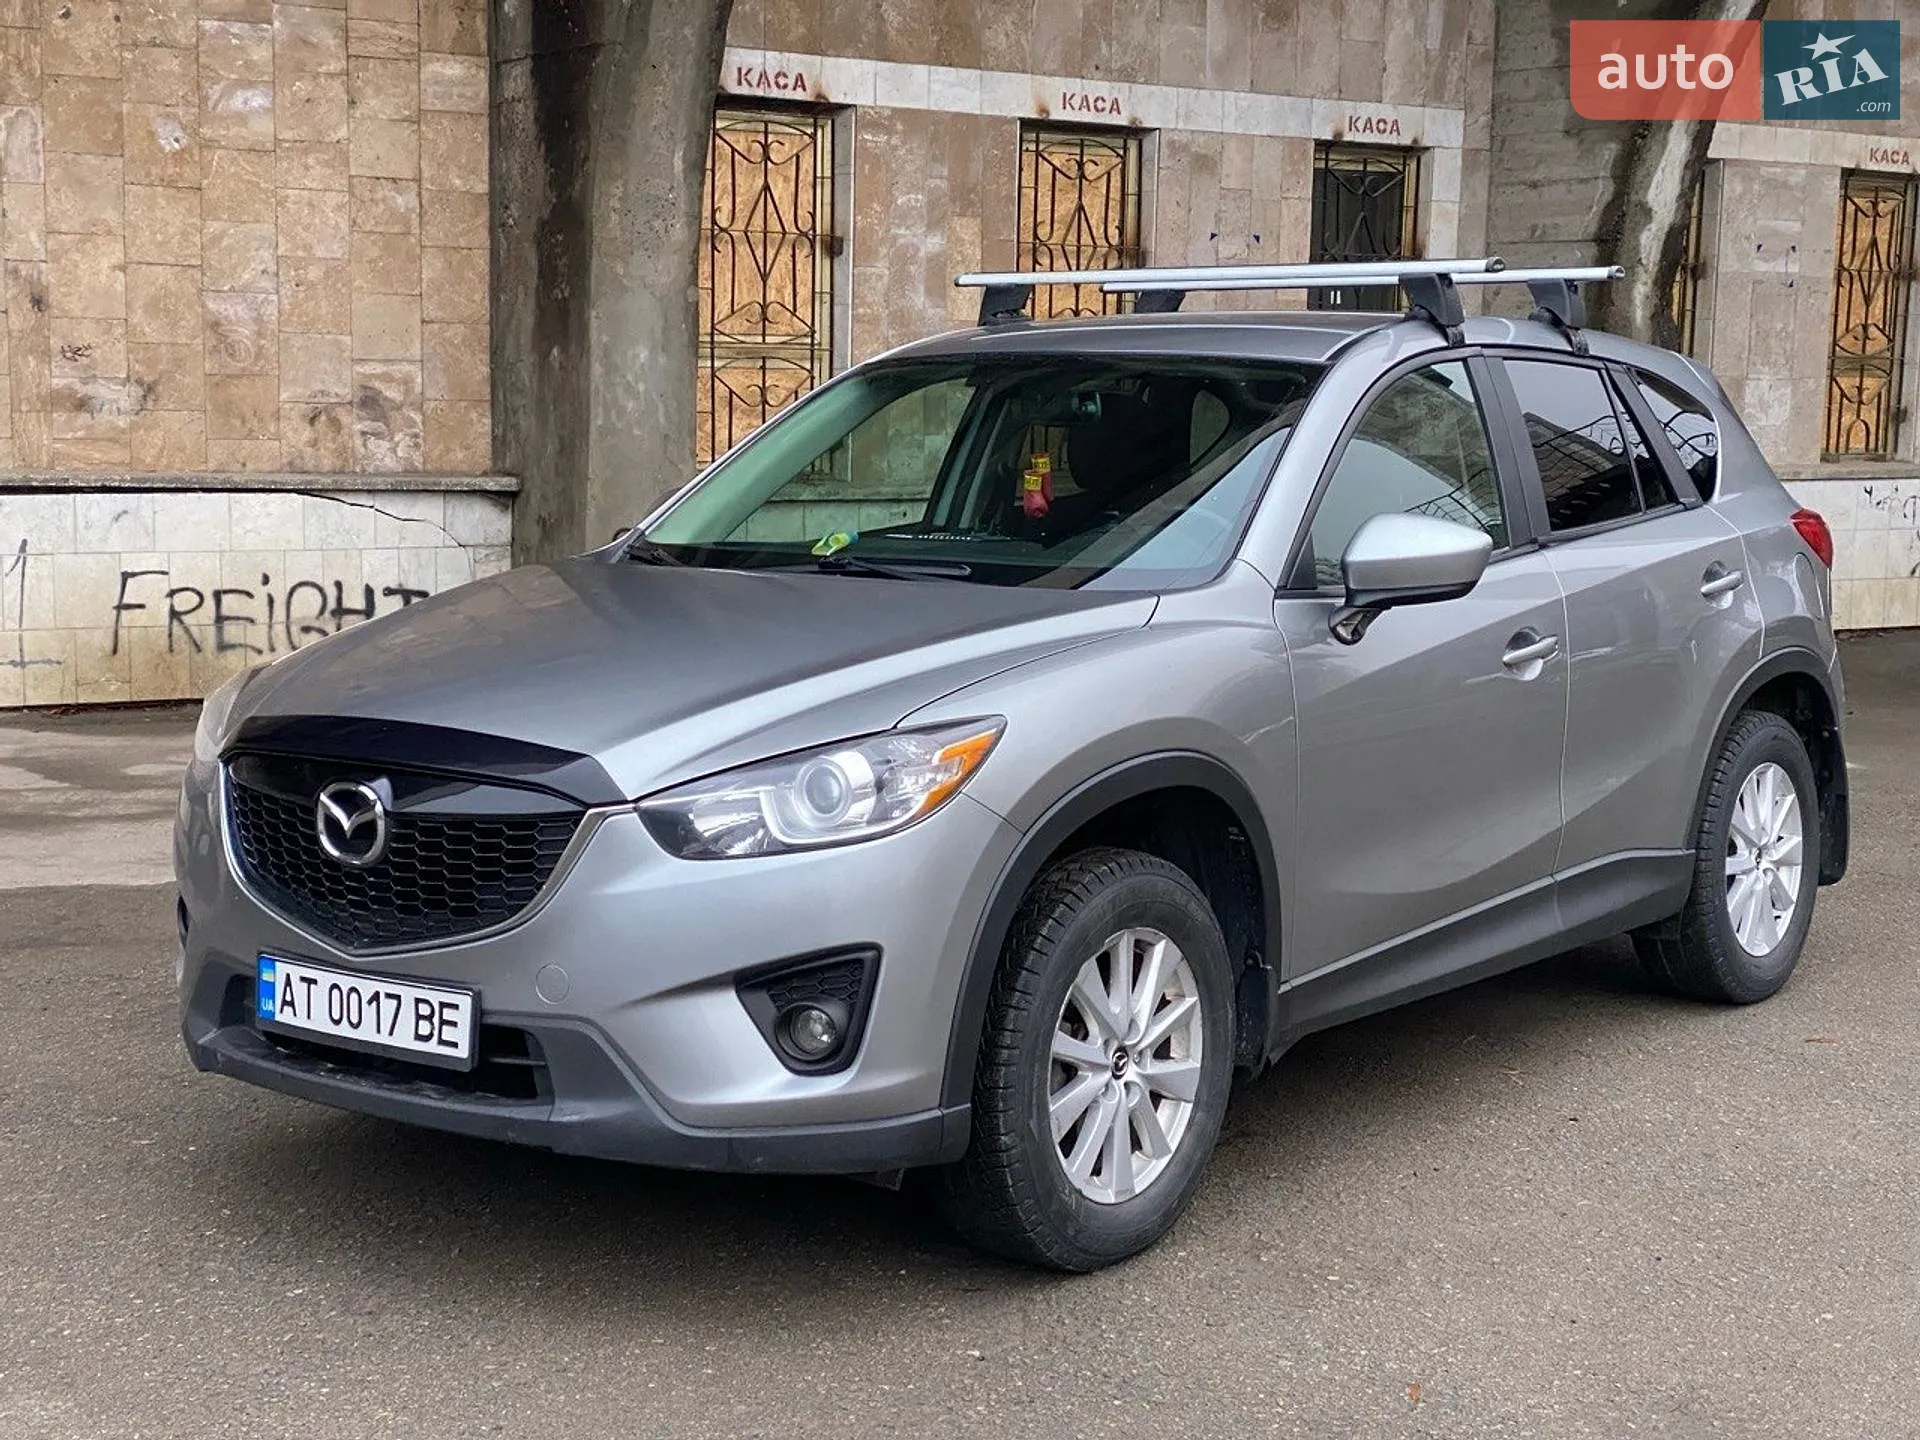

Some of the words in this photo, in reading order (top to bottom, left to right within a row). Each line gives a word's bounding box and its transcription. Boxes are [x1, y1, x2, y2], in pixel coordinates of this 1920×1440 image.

[737, 66, 806, 93] КАСА
[1062, 91, 1121, 115] КАСА
[1348, 115, 1401, 136] КАСА
[1868, 147, 1910, 165] КАСА
[261, 998, 274, 1011] UA
[279, 972, 318, 1020] AT
[328, 982, 402, 1037] 0017
[413, 996, 460, 1049] BE
